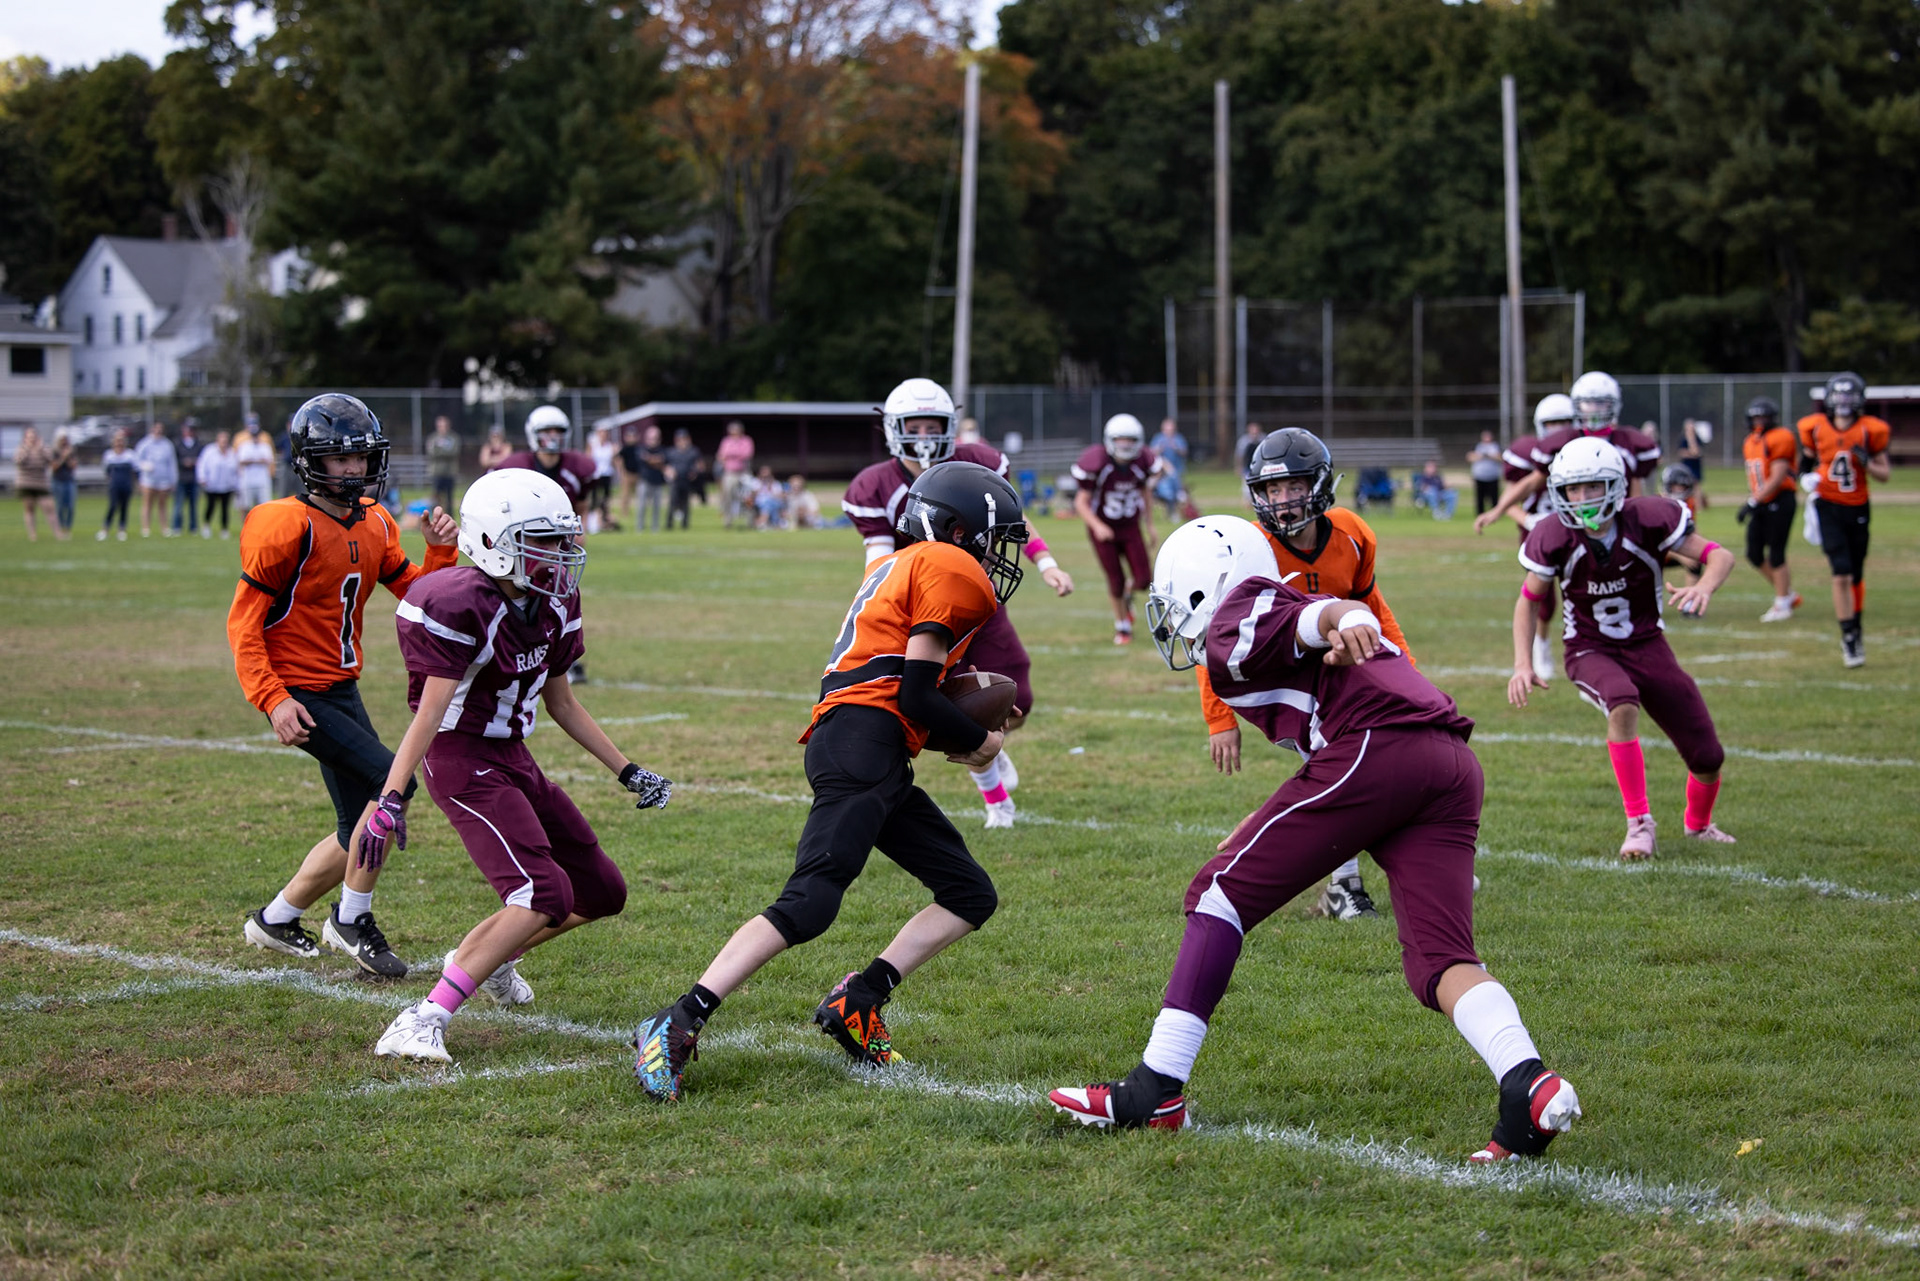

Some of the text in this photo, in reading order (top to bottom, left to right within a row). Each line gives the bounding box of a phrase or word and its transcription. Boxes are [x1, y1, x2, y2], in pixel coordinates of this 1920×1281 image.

[1827, 450, 1857, 493] 4
[348, 540, 359, 565] U
[1305, 572, 1319, 593] U
[1587, 577, 1627, 596] RAMS
[340, 572, 361, 668] 1
[1592, 596, 1634, 640] 8
[515, 644, 550, 673] RAMS
